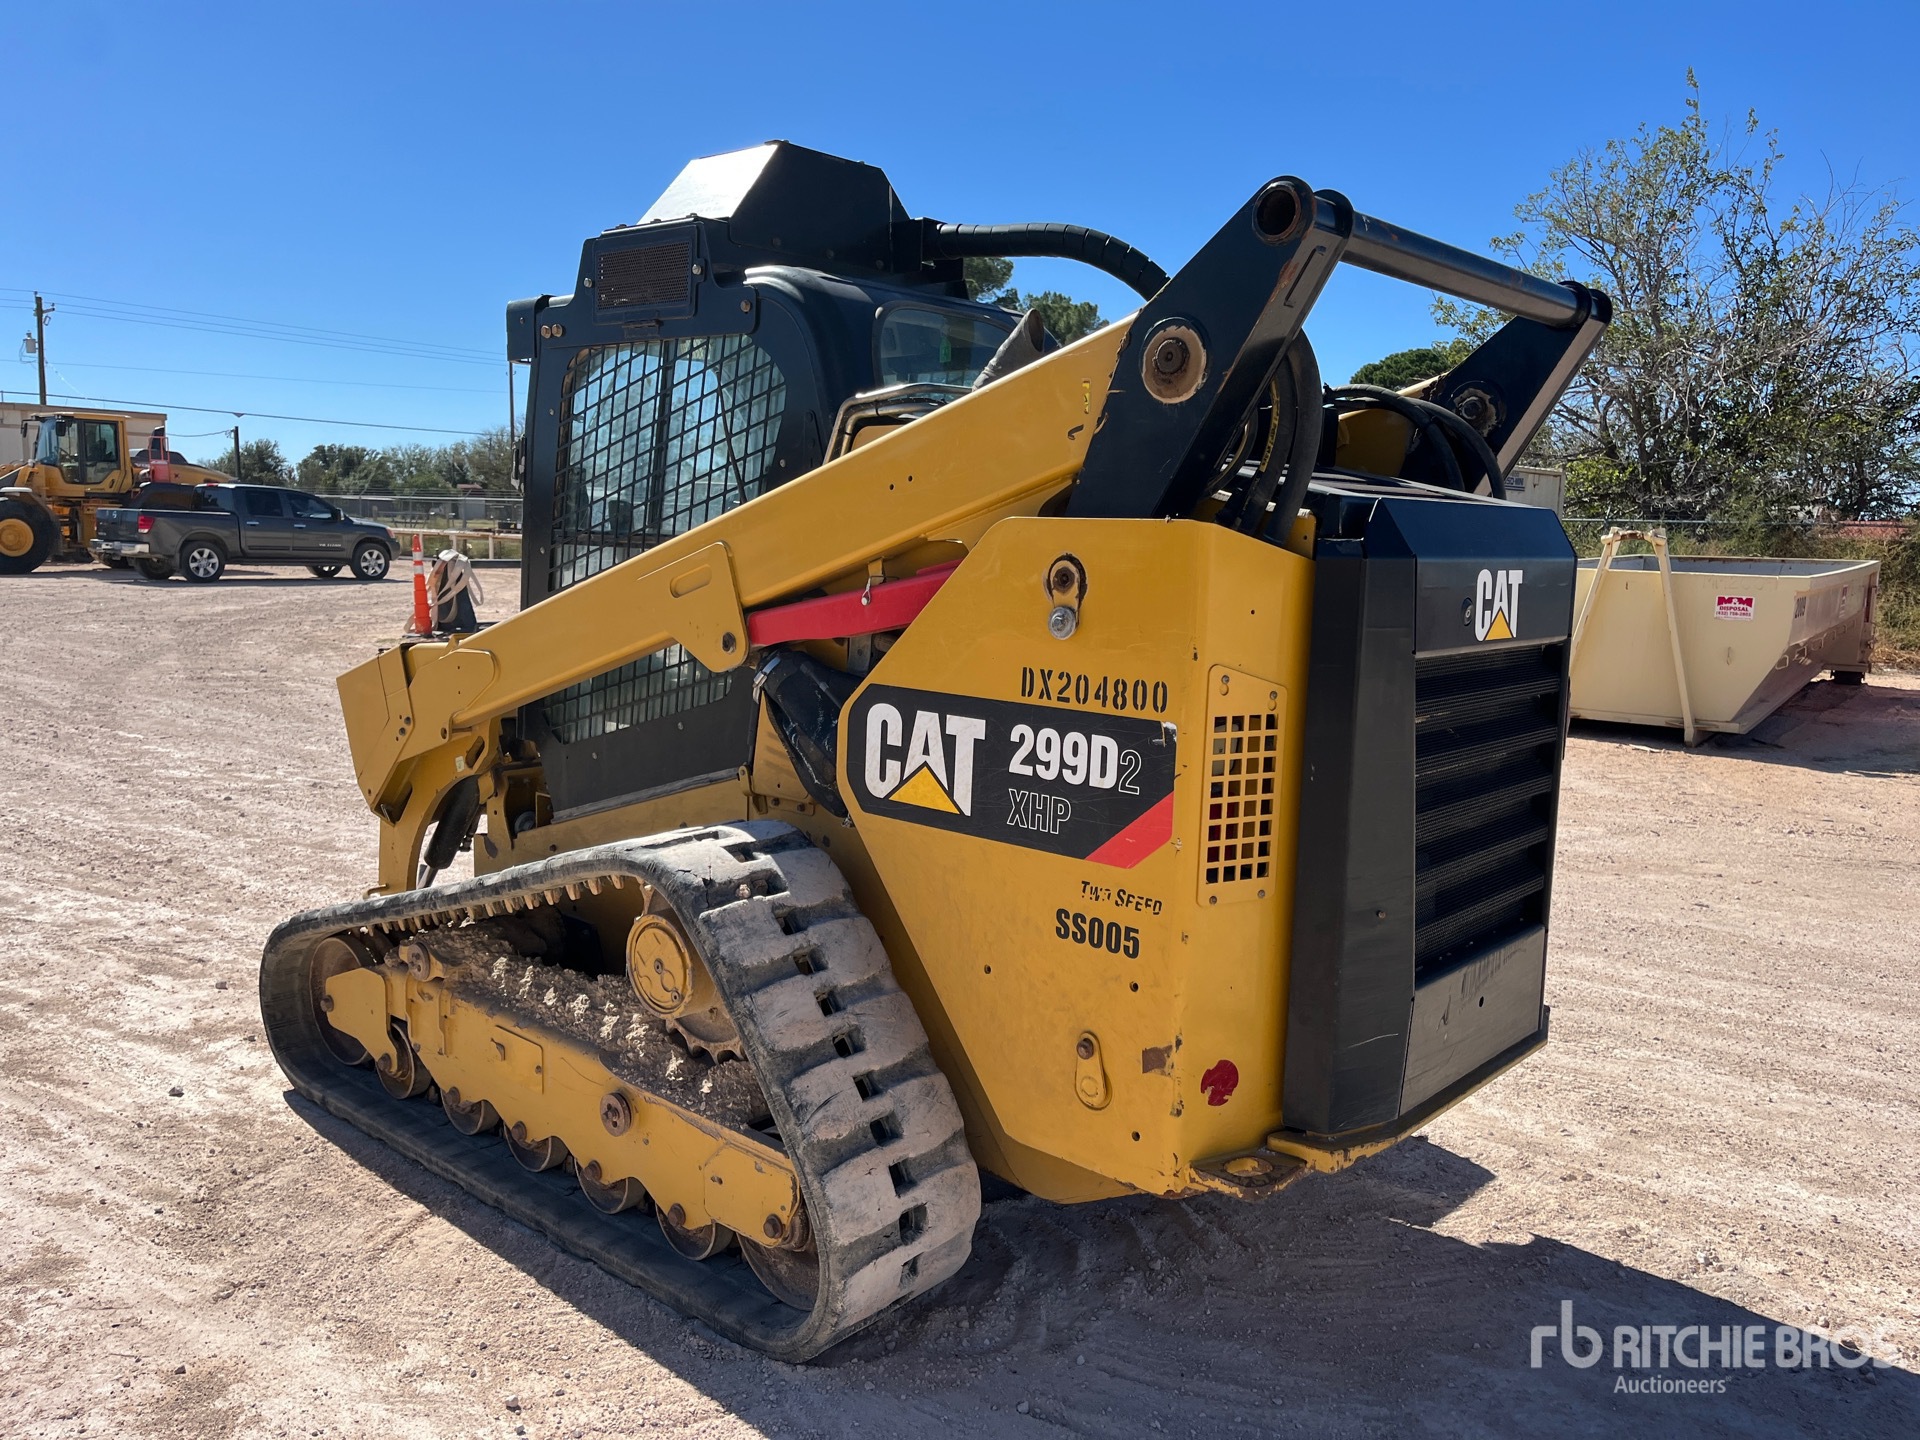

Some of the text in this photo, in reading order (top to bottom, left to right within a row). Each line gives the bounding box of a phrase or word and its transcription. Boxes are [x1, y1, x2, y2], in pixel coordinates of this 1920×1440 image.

[1474, 568, 1523, 641] CAT
[1717, 596, 1754, 608] M&M
[1021, 667, 1168, 713] DX204800
[864, 703, 986, 816] CAT
[1008, 724, 1142, 795] 299D2
[1006, 788, 1072, 835] XHP
[1055, 908, 1140, 959] SS005
